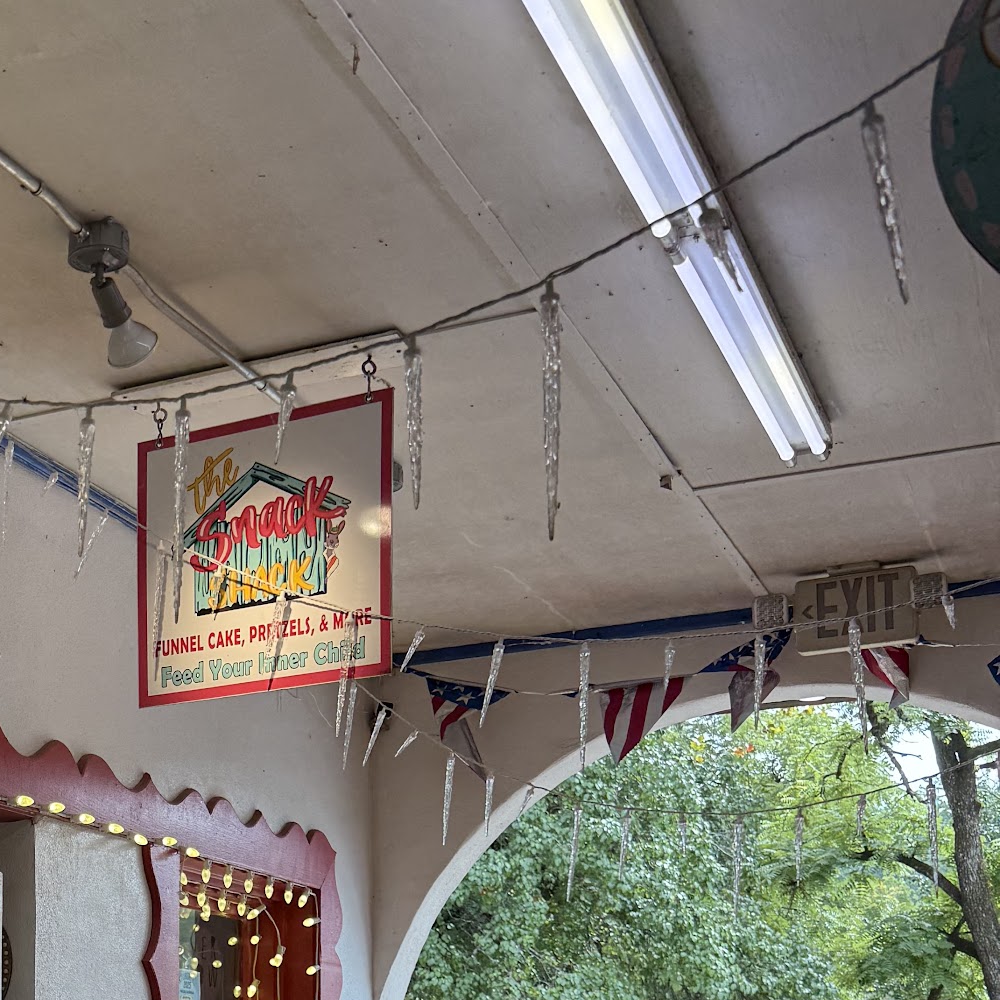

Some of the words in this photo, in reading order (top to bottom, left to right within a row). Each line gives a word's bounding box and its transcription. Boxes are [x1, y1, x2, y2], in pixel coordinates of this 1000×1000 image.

[187, 448, 239, 514] the
[208, 556, 314, 609] SHACK
[816, 572, 899, 639] EXIT
[208, 628, 244, 648] CAKE,
[319, 614, 329, 632] &
[333, 607, 372, 630] MRE
[161, 661, 204, 688] Feed
[209, 659, 254, 681] Your
[258, 652, 308, 675] Inner
[313, 636, 366, 665] Chid
